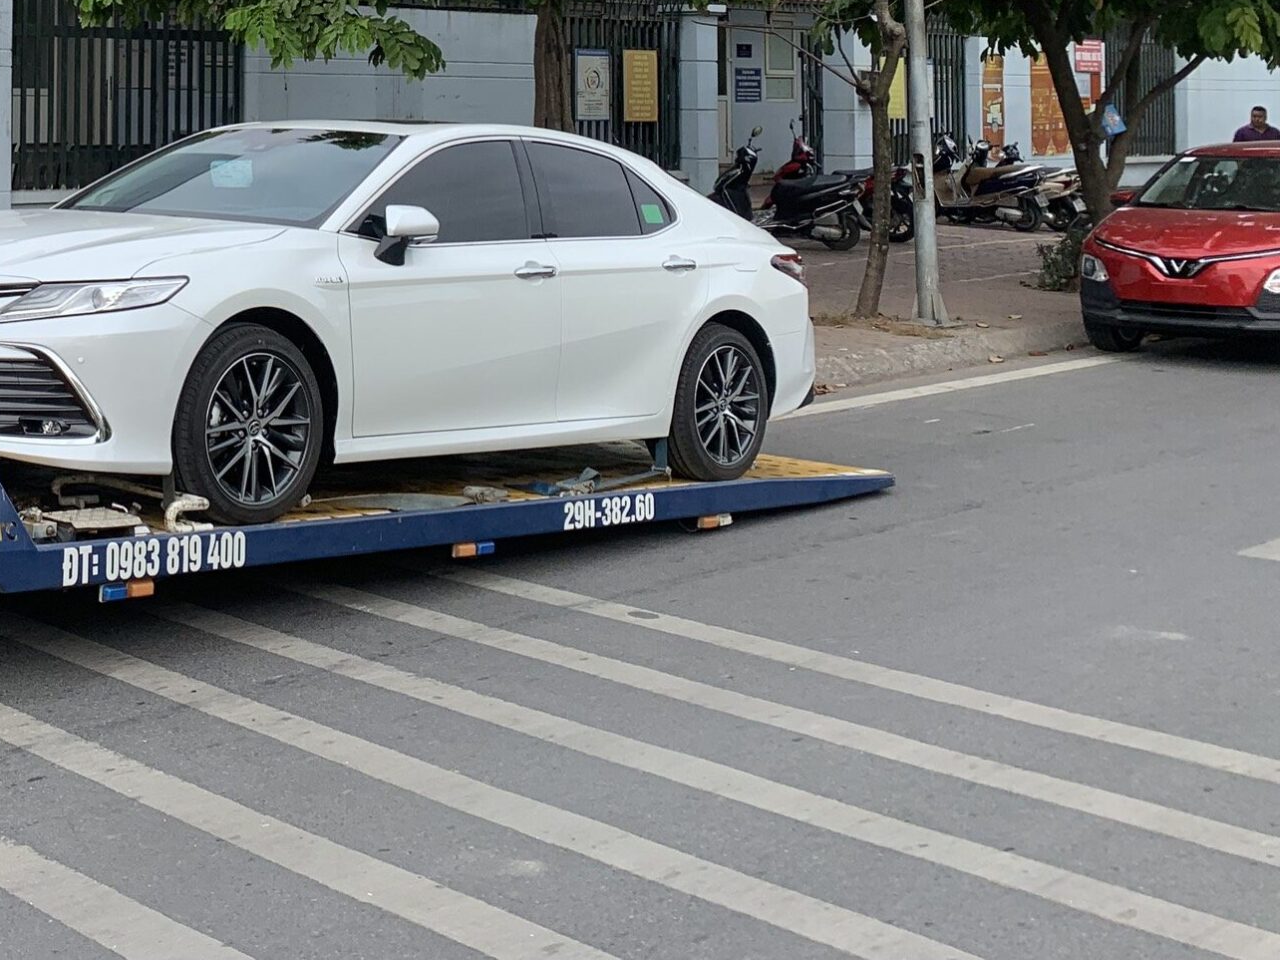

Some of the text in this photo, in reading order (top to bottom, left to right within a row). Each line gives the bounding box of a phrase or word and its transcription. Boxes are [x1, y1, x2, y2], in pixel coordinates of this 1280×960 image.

[563, 492, 655, 531] 29H-382.60
[62, 531, 246, 586] ĐT: 0983 819 400
